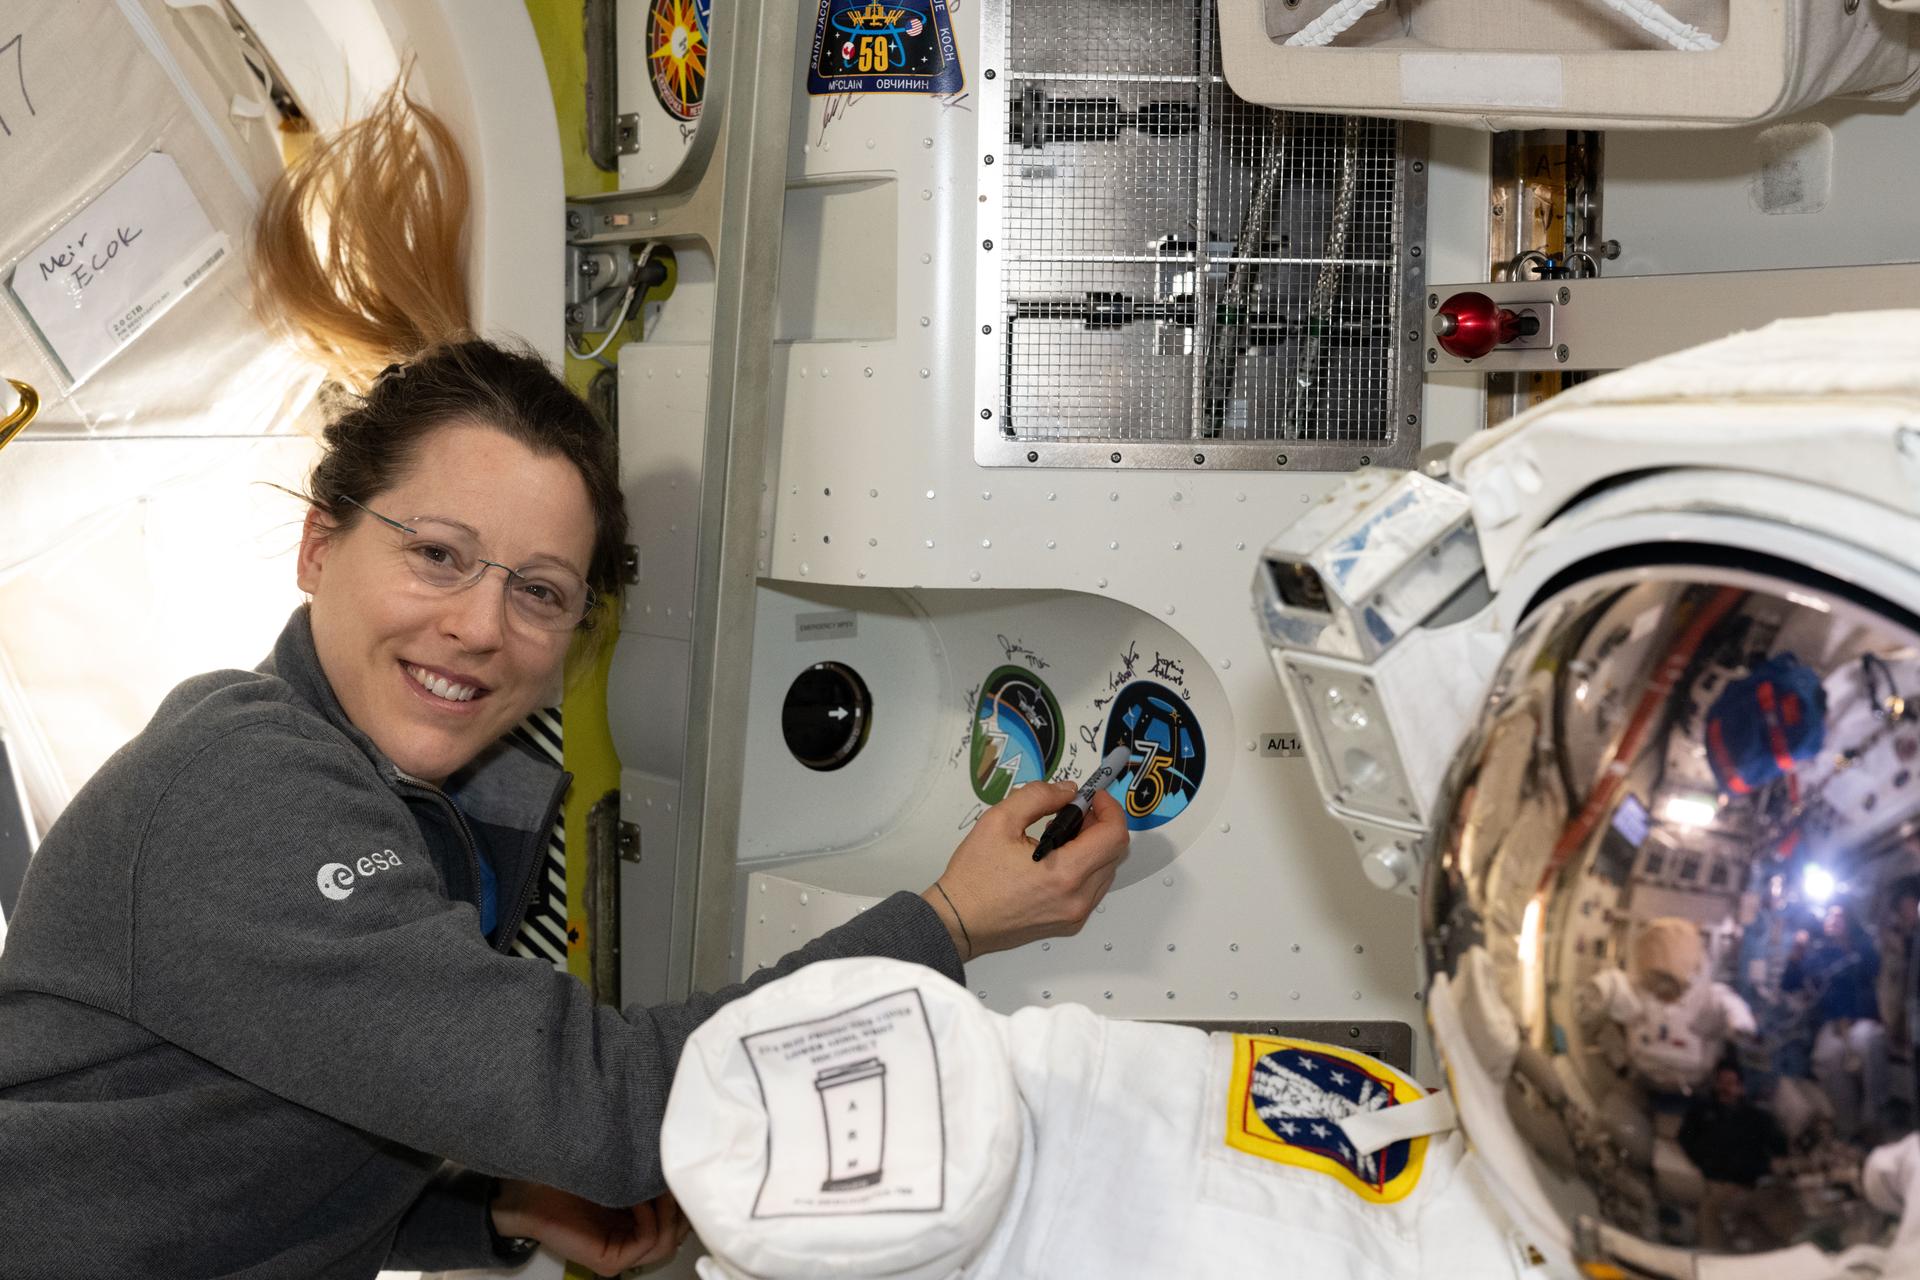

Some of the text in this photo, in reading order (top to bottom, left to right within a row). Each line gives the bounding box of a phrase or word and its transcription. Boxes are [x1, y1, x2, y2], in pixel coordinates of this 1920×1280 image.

[858, 36, 889, 72] 59
[940, 28, 956, 61] KOCH
[876, 79, 929, 90] ОВЧИНИН
[39, 232, 87, 281] Meir
[1125, 740, 1174, 818] 75
[356, 849, 402, 876] esa
